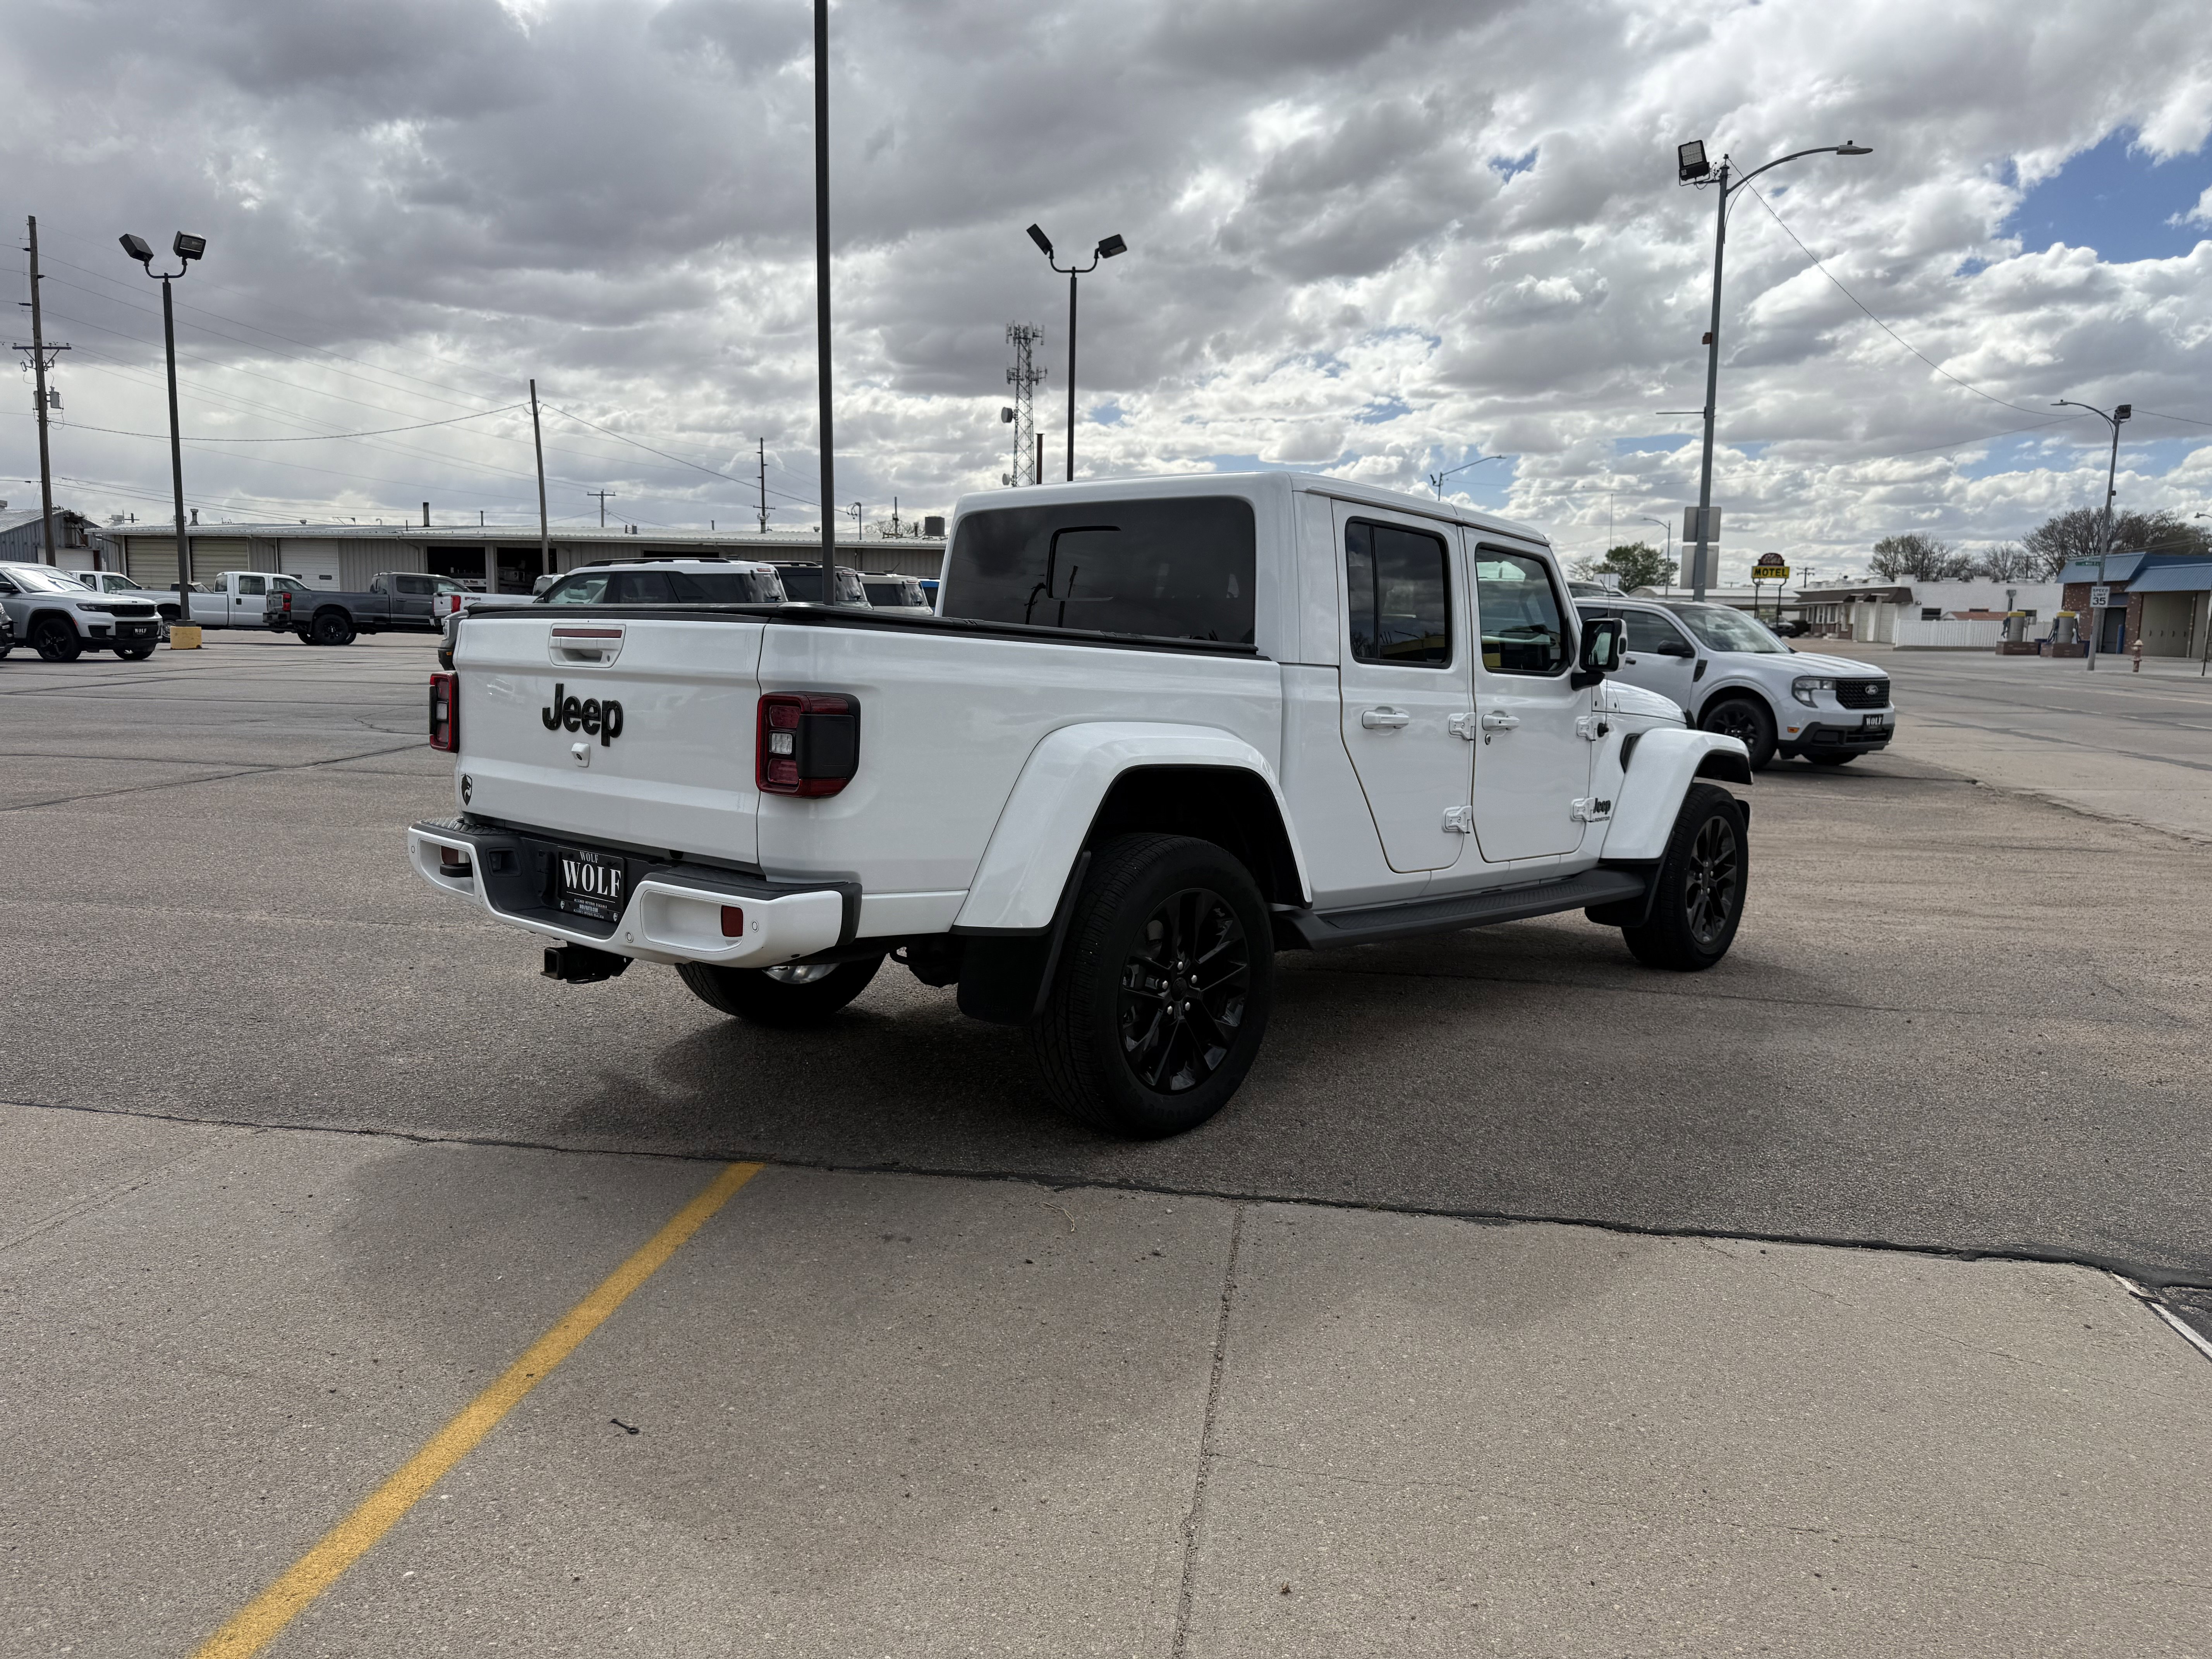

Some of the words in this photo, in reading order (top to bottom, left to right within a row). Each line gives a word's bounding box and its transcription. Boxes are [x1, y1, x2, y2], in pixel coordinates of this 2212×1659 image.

[1754, 568, 1787, 576] MOTEL
[542, 683, 623, 747] Jeep
[1866, 716, 1882, 725] WOLF
[1593, 798, 1611, 815] Jeep
[580, 851, 598, 863] WOLF
[562, 859, 621, 898] WOLF
